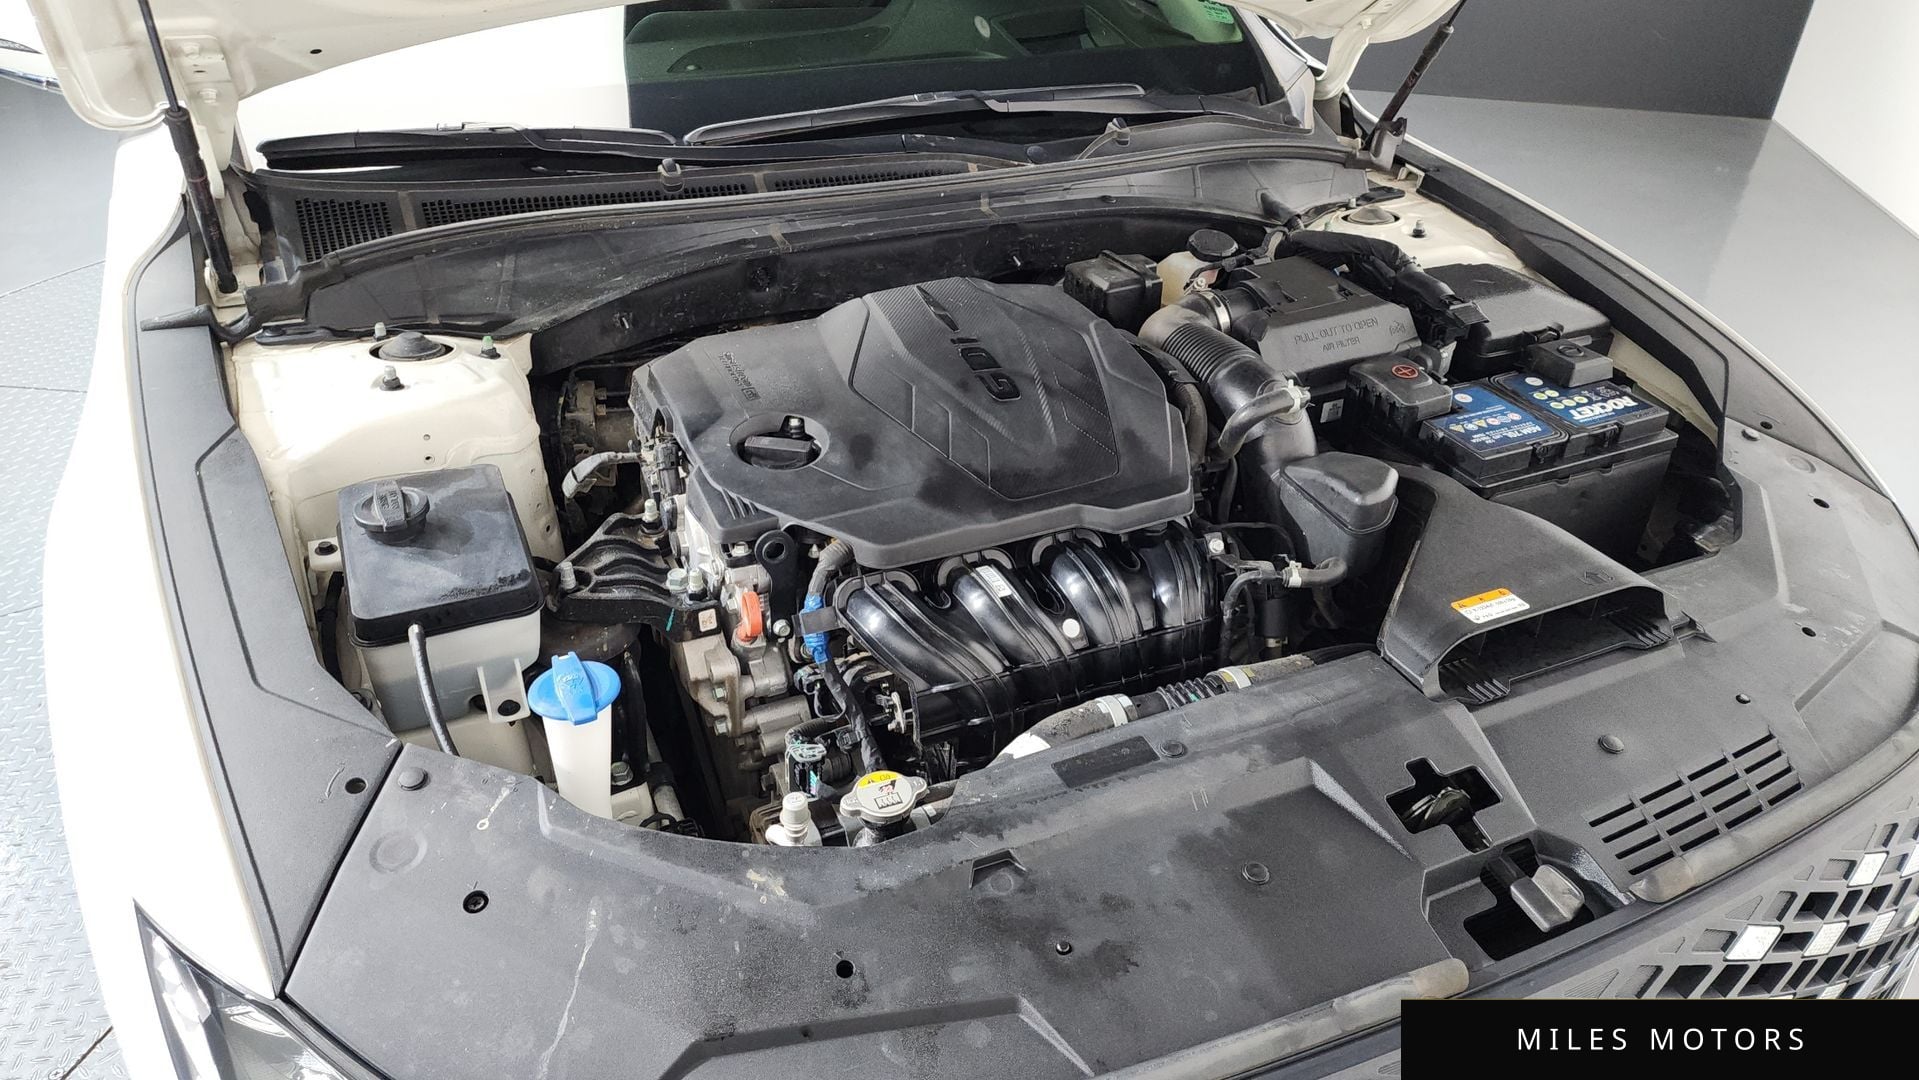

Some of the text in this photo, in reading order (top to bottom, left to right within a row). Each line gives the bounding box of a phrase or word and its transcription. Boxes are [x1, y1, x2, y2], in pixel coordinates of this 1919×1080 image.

[1294, 331, 1319, 345] PULL
[1320, 326, 1338, 339] OUT
[1340, 323, 1353, 334] TO
[1353, 317, 1379, 331] OPEN
[1322, 336, 1361, 352] AIR FILTER
[1569, 396, 1639, 420] ROCKET
